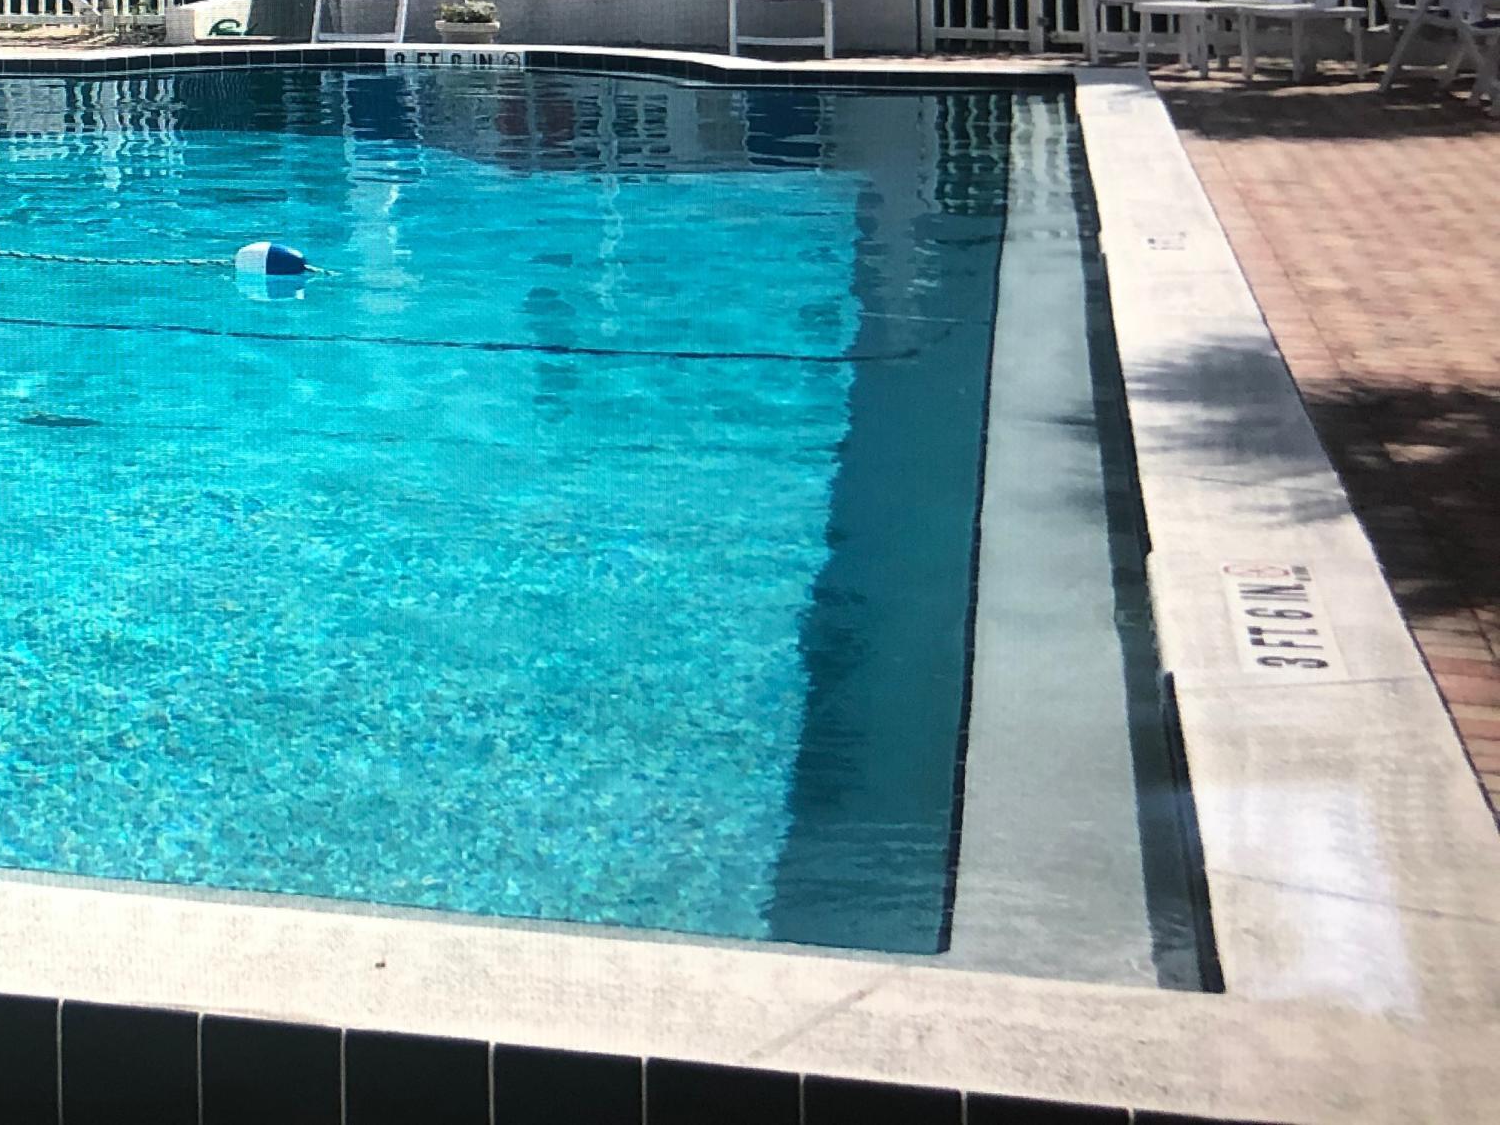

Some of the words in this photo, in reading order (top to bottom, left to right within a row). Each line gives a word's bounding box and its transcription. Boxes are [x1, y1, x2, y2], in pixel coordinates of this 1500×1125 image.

[1245, 608, 1312, 619] 6
[1247, 626, 1325, 650] FT
[1256, 656, 1328, 668] 3
